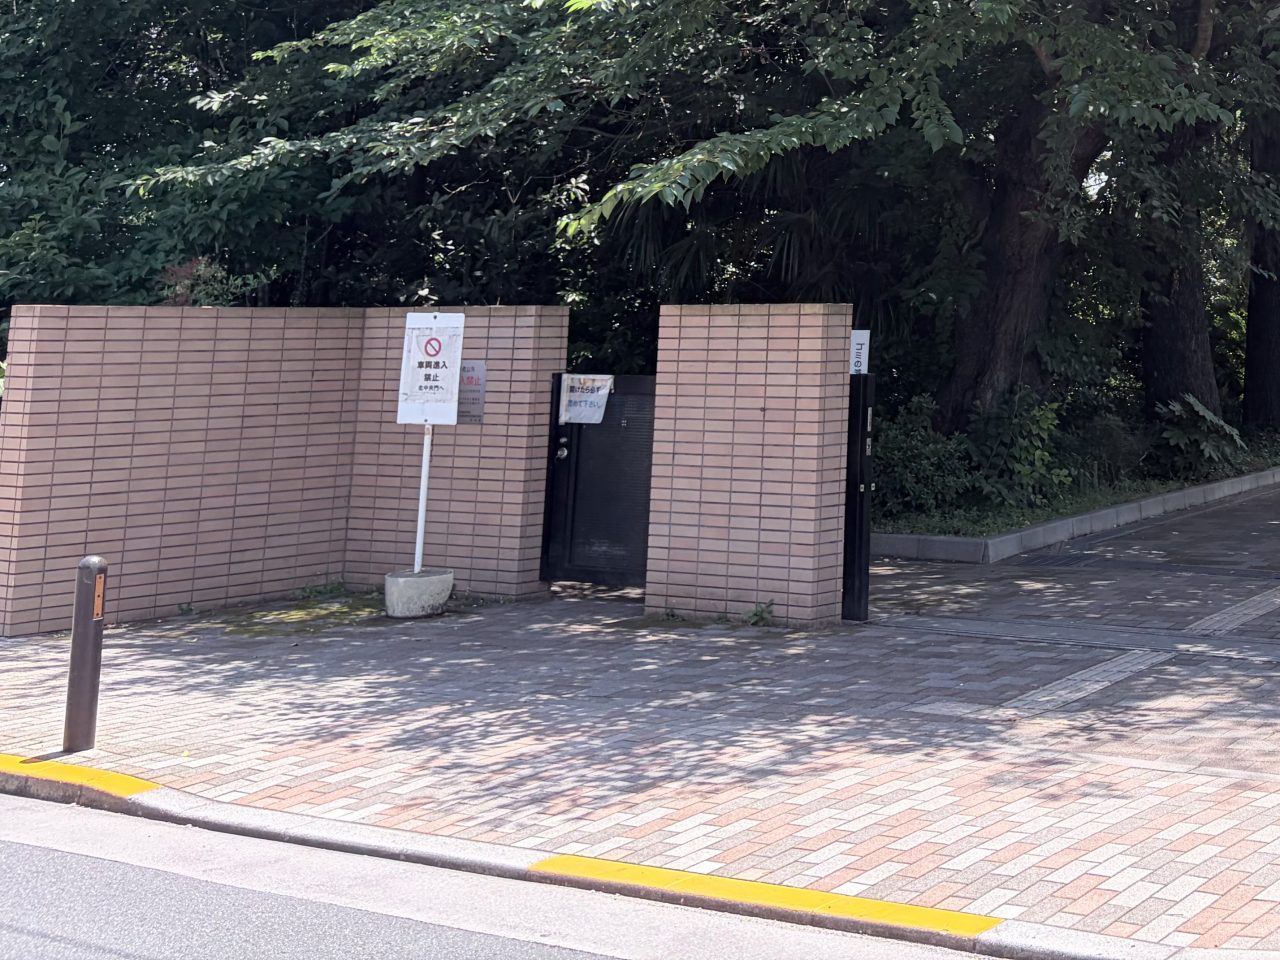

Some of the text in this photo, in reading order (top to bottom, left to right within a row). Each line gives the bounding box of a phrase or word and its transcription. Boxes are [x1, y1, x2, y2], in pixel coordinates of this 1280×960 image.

[417, 360, 448, 370] 車両進入
[423, 373, 440, 382] 禁止
